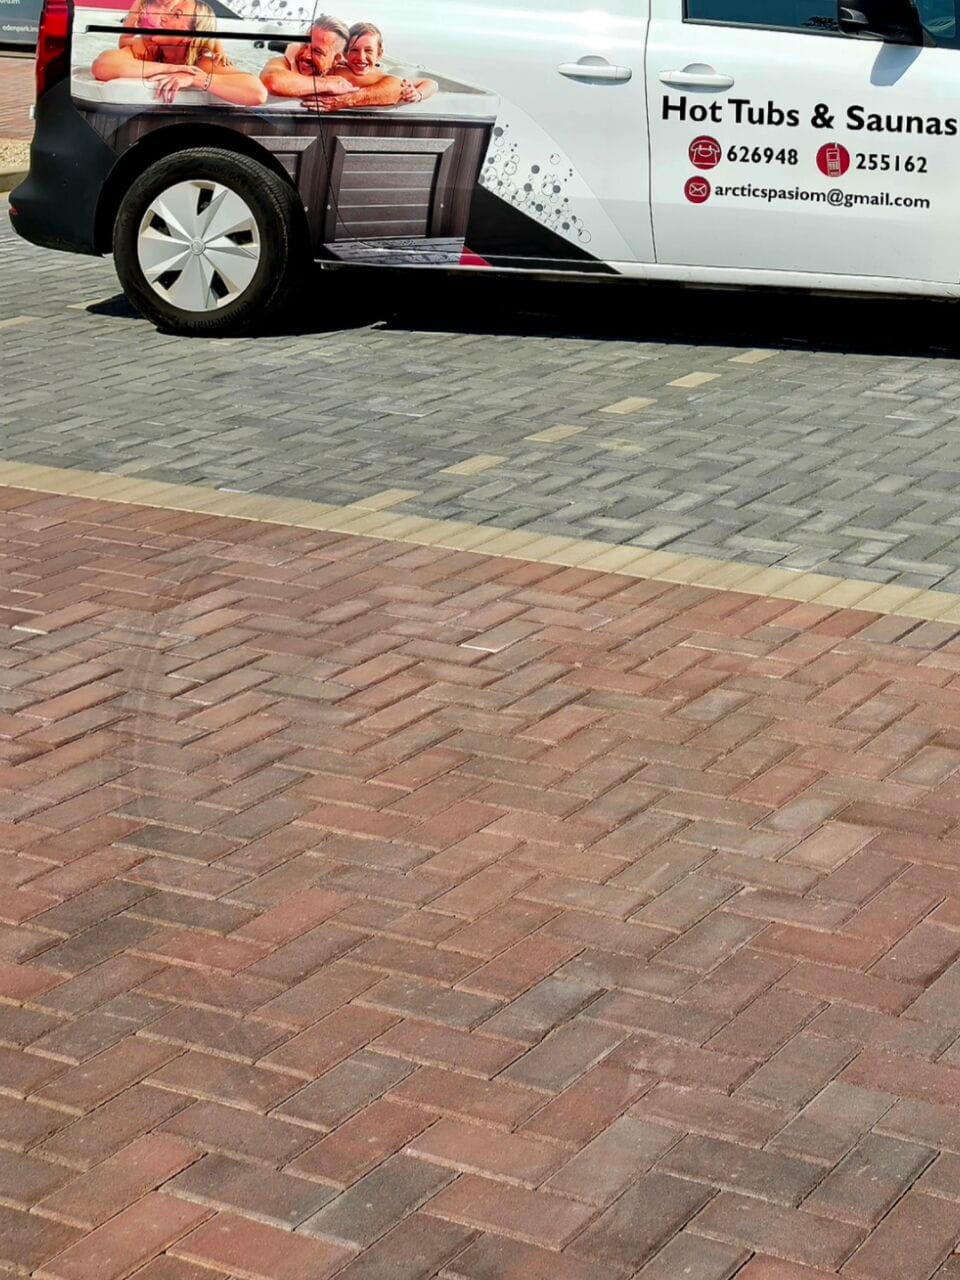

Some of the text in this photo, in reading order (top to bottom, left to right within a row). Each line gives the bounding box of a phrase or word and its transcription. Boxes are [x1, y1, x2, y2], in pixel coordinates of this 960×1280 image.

[662, 95, 958, 136] Hot Tubs & Saunas
[726, 145, 798, 165] 626948
[855, 153, 928, 174] 255162
[714, 184, 930, 209] arcticspasiom@gmail.com
